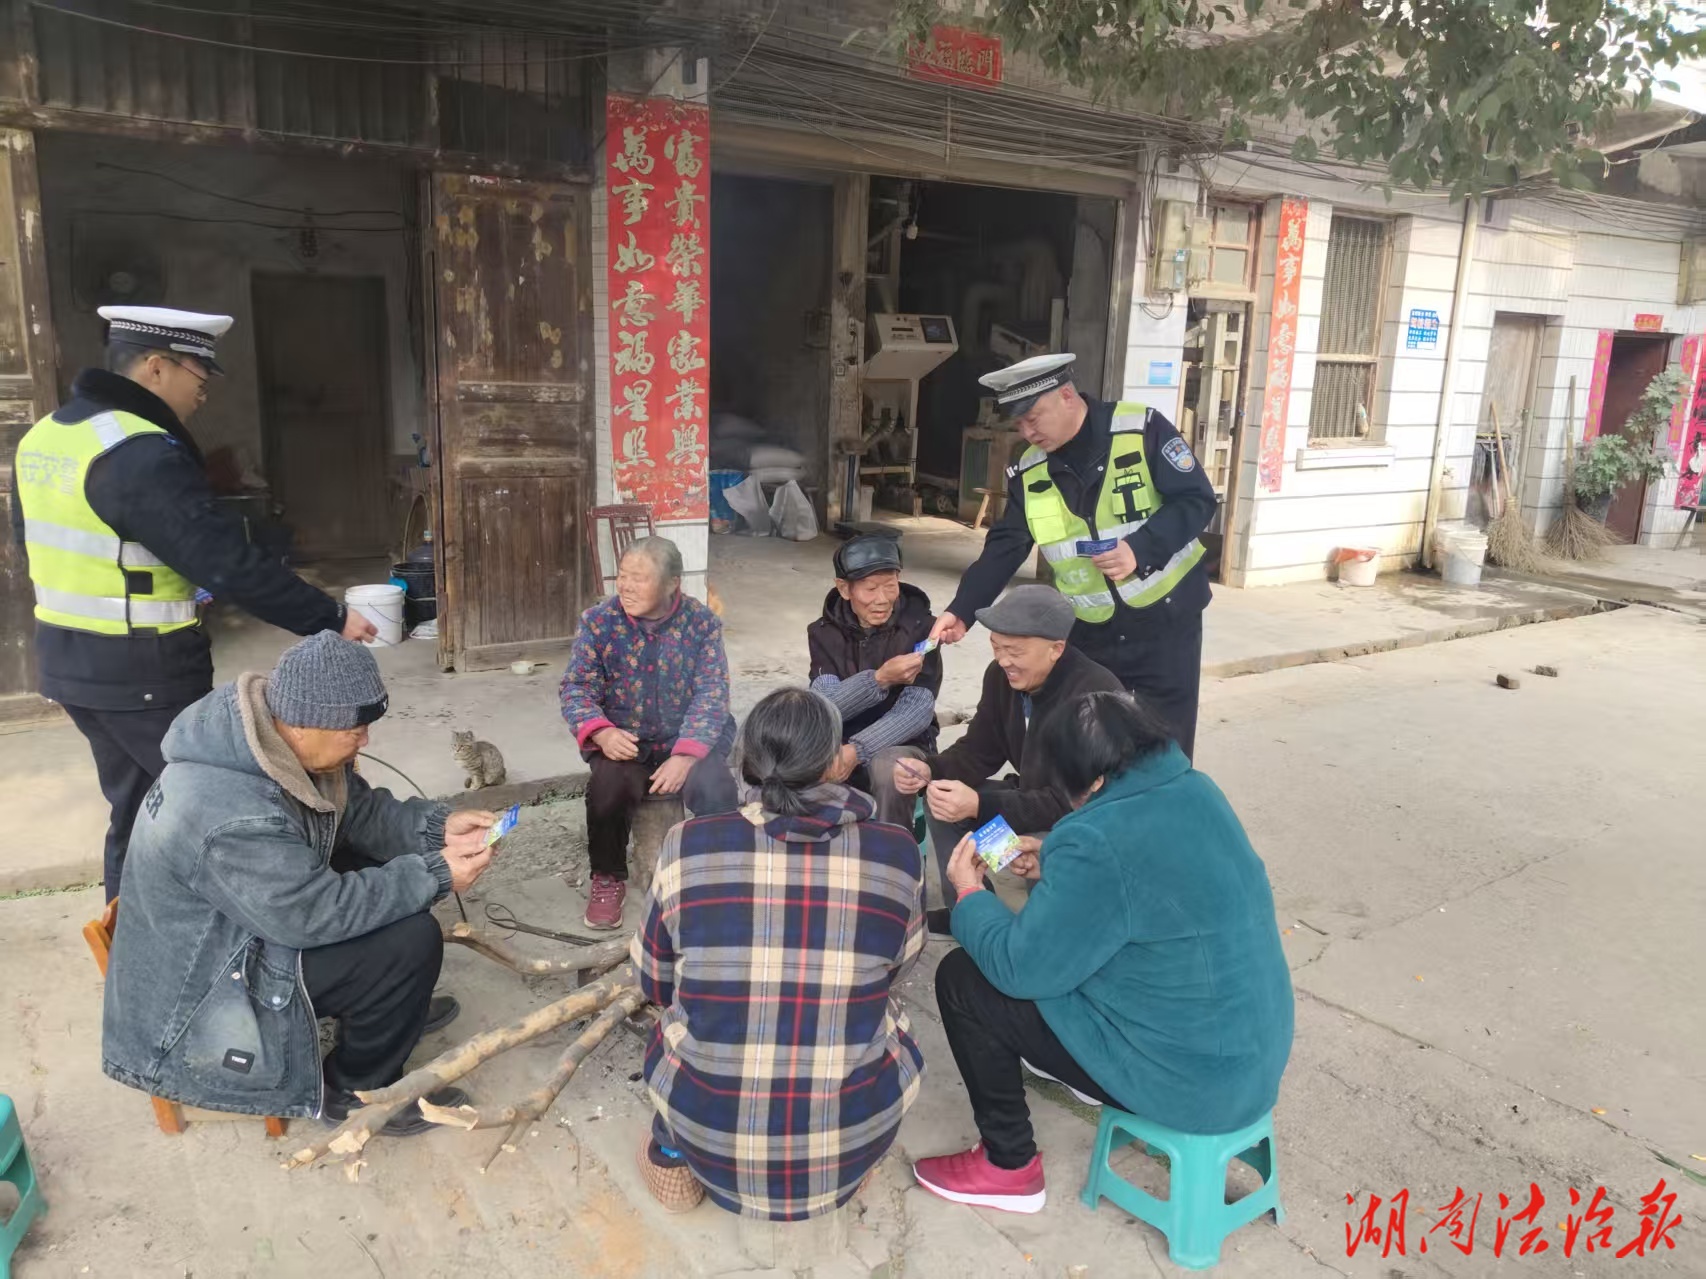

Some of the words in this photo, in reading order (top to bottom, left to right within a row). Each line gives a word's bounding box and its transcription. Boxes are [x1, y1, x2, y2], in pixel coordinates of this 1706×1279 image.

[611, 126, 657, 469] 萬事如意福星照
